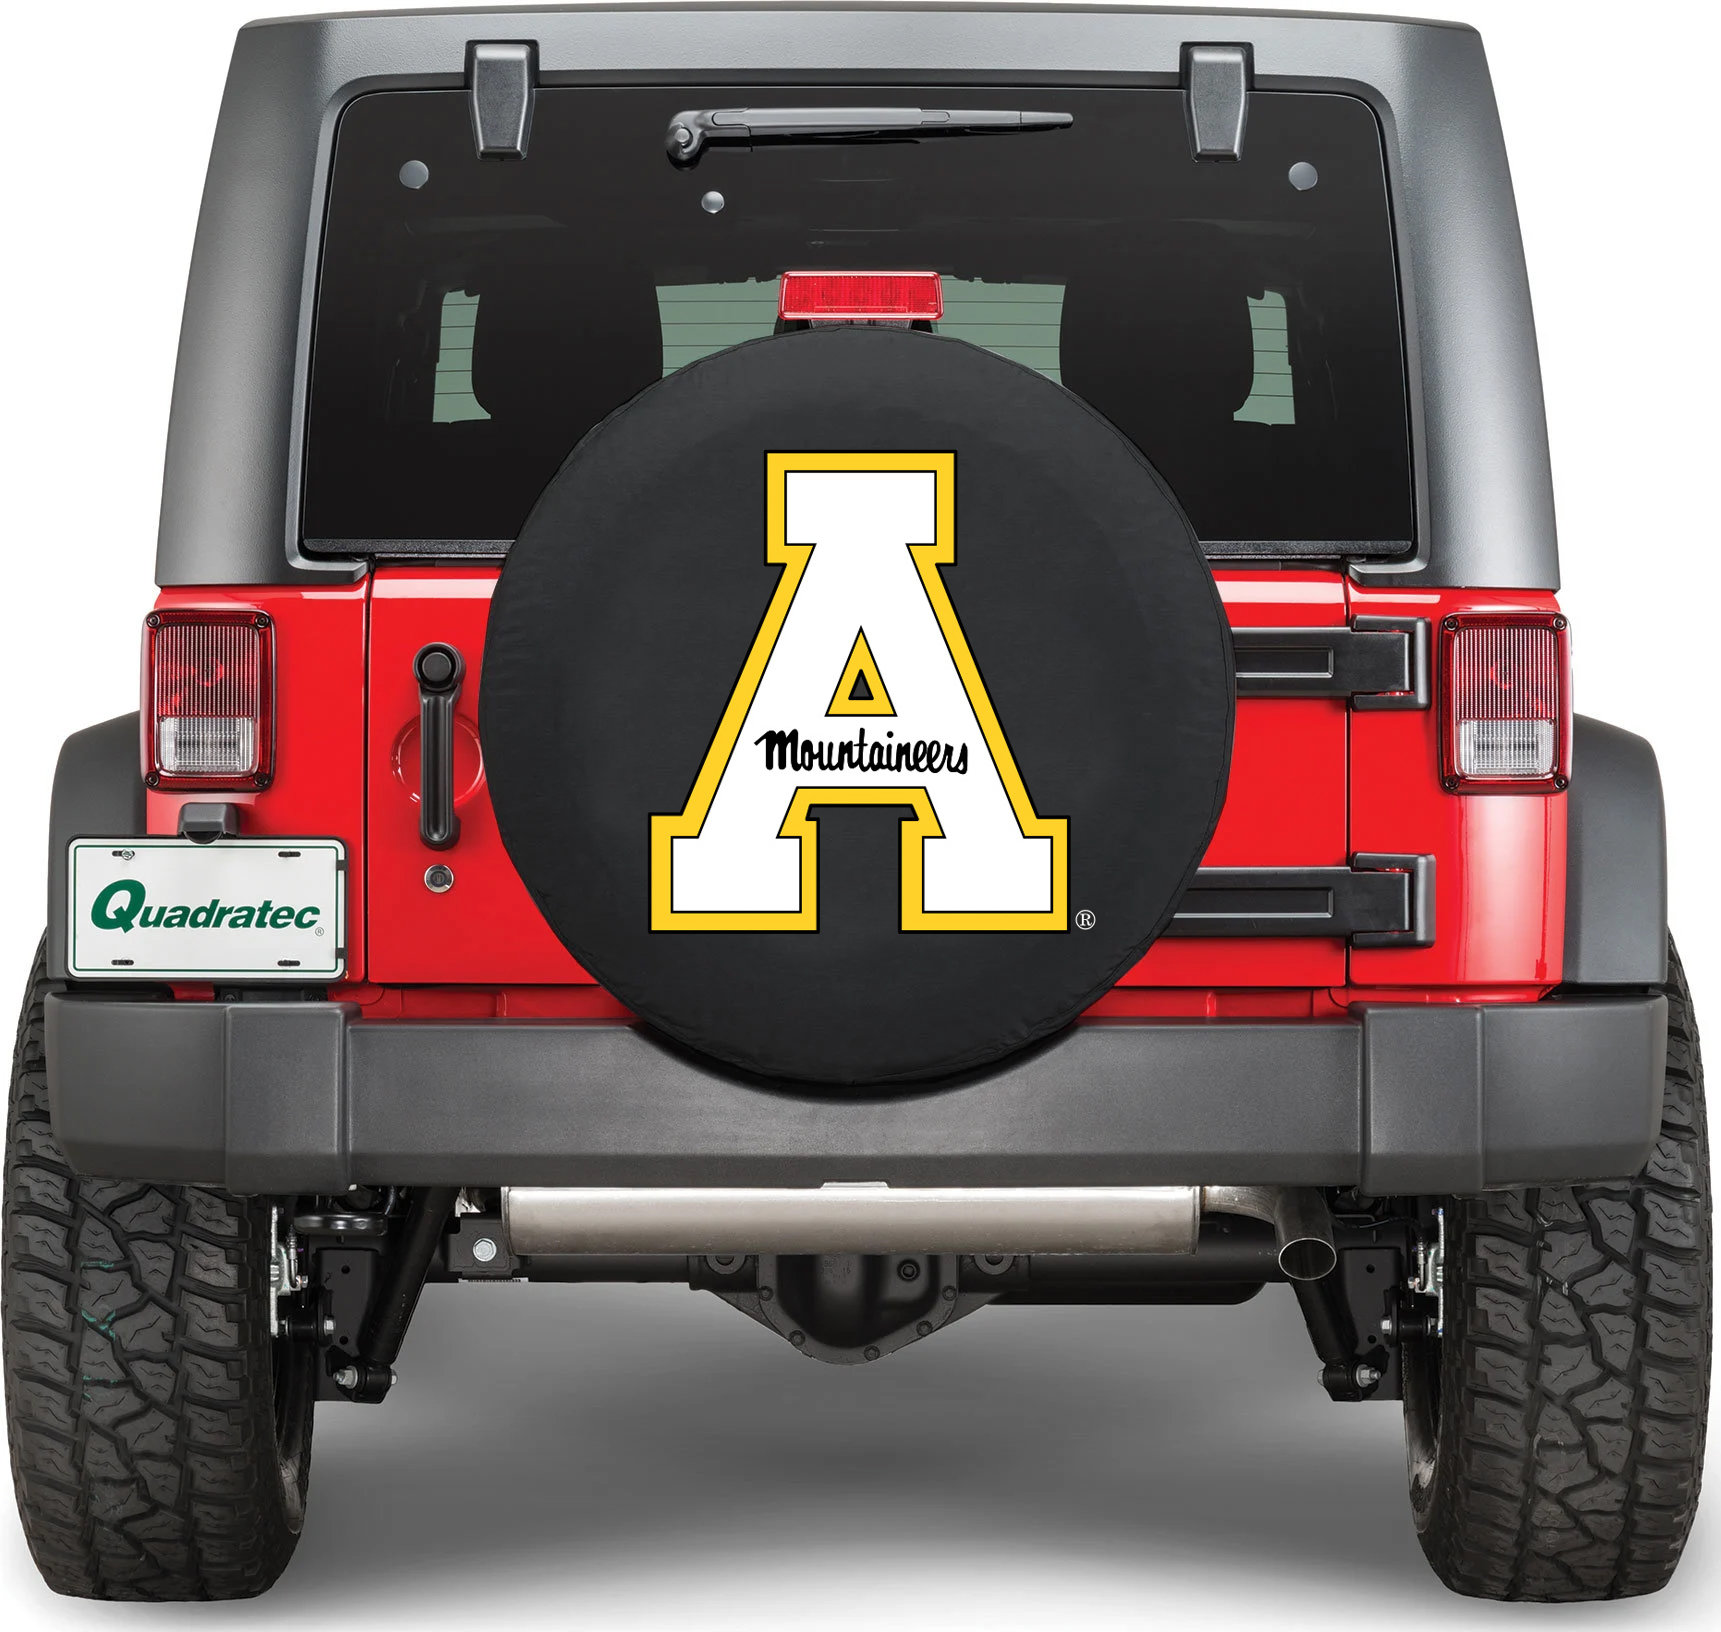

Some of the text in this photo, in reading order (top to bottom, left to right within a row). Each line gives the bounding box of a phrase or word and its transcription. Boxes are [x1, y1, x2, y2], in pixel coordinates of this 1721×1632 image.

[650, 449, 1071, 934] A
[754, 727, 968, 775] Mountaineers
[91, 879, 321, 933] Quadratec
